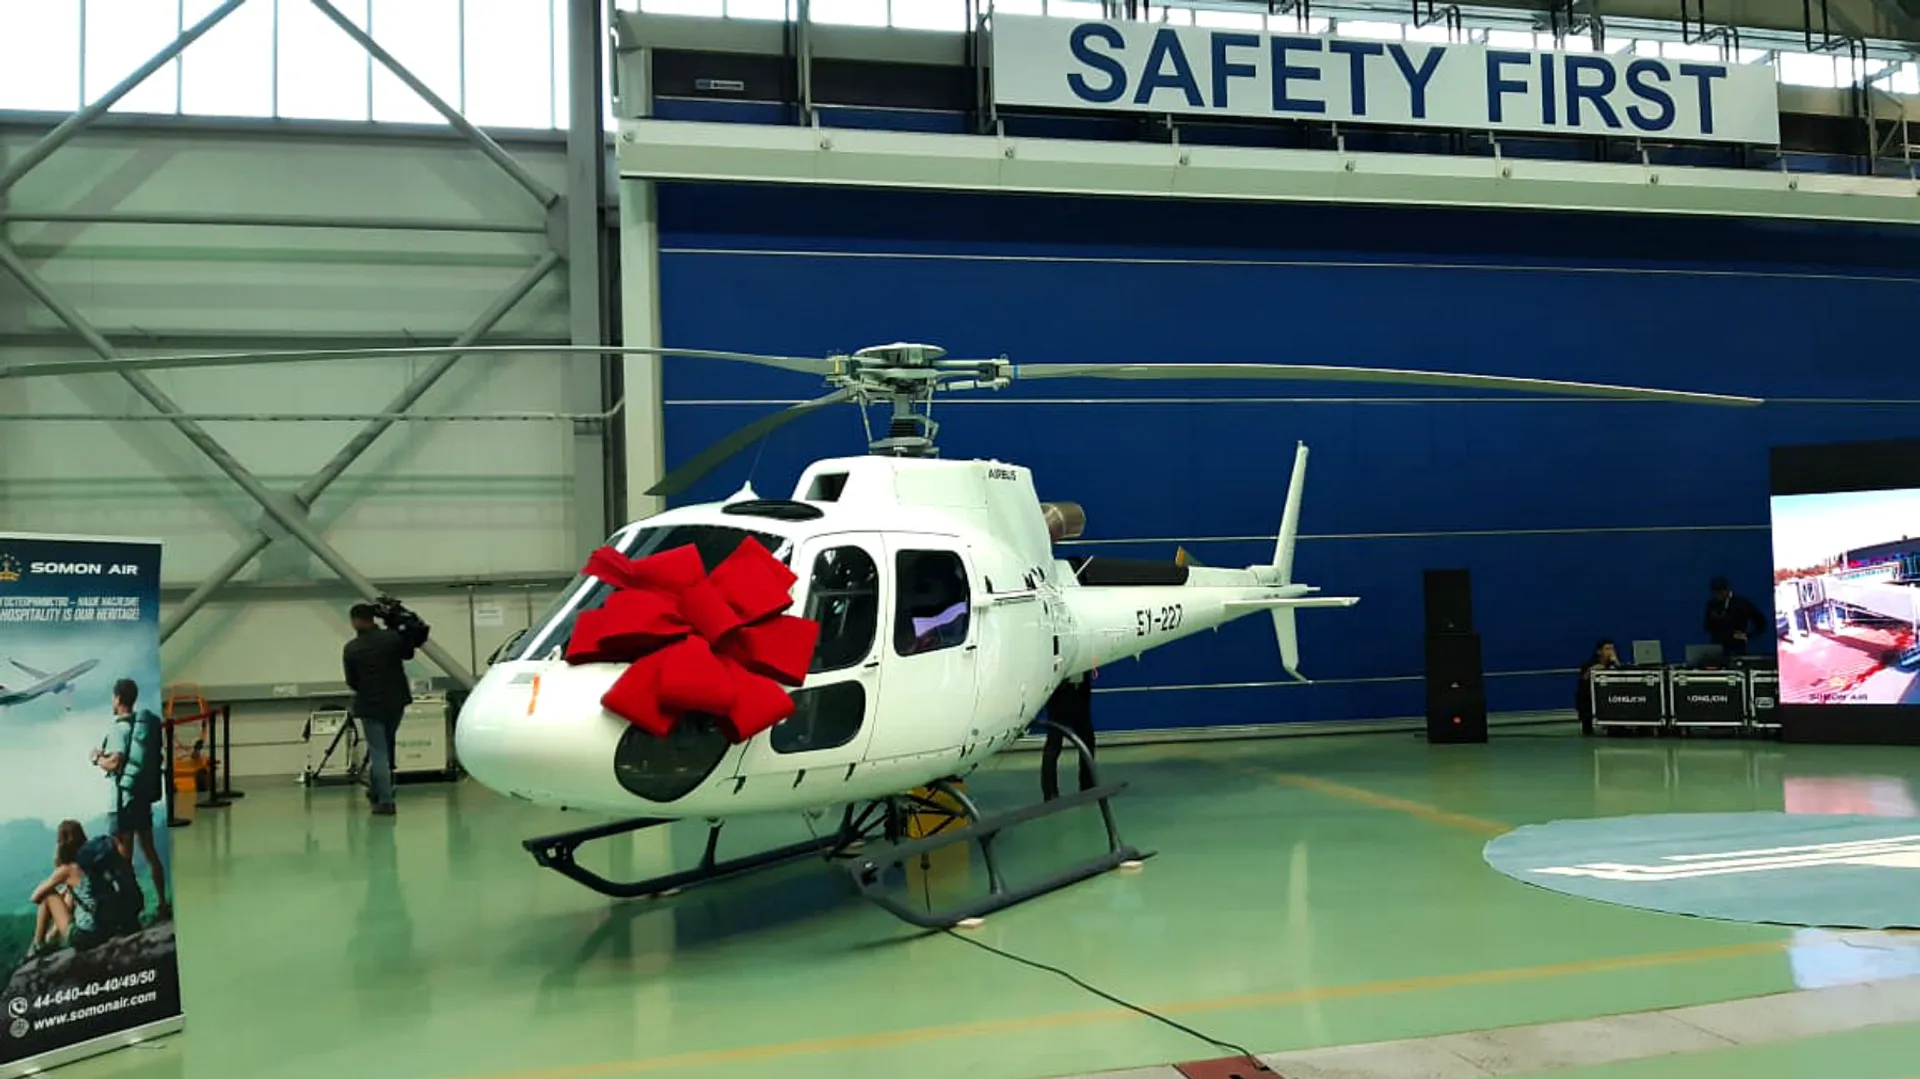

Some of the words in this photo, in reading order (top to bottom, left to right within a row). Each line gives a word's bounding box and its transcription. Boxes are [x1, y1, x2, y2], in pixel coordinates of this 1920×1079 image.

[1066, 22, 1446, 120] SAFETY
[1485, 49, 1729, 135] FIRST
[30, 561, 101, 575] SOMON
[107, 564, 139, 576] AIR
[1136, 603, 1183, 637] EY-227
[33, 969, 157, 1009] 44-640-40-40/49/50
[33, 991, 157, 1031] www.somonair.com
